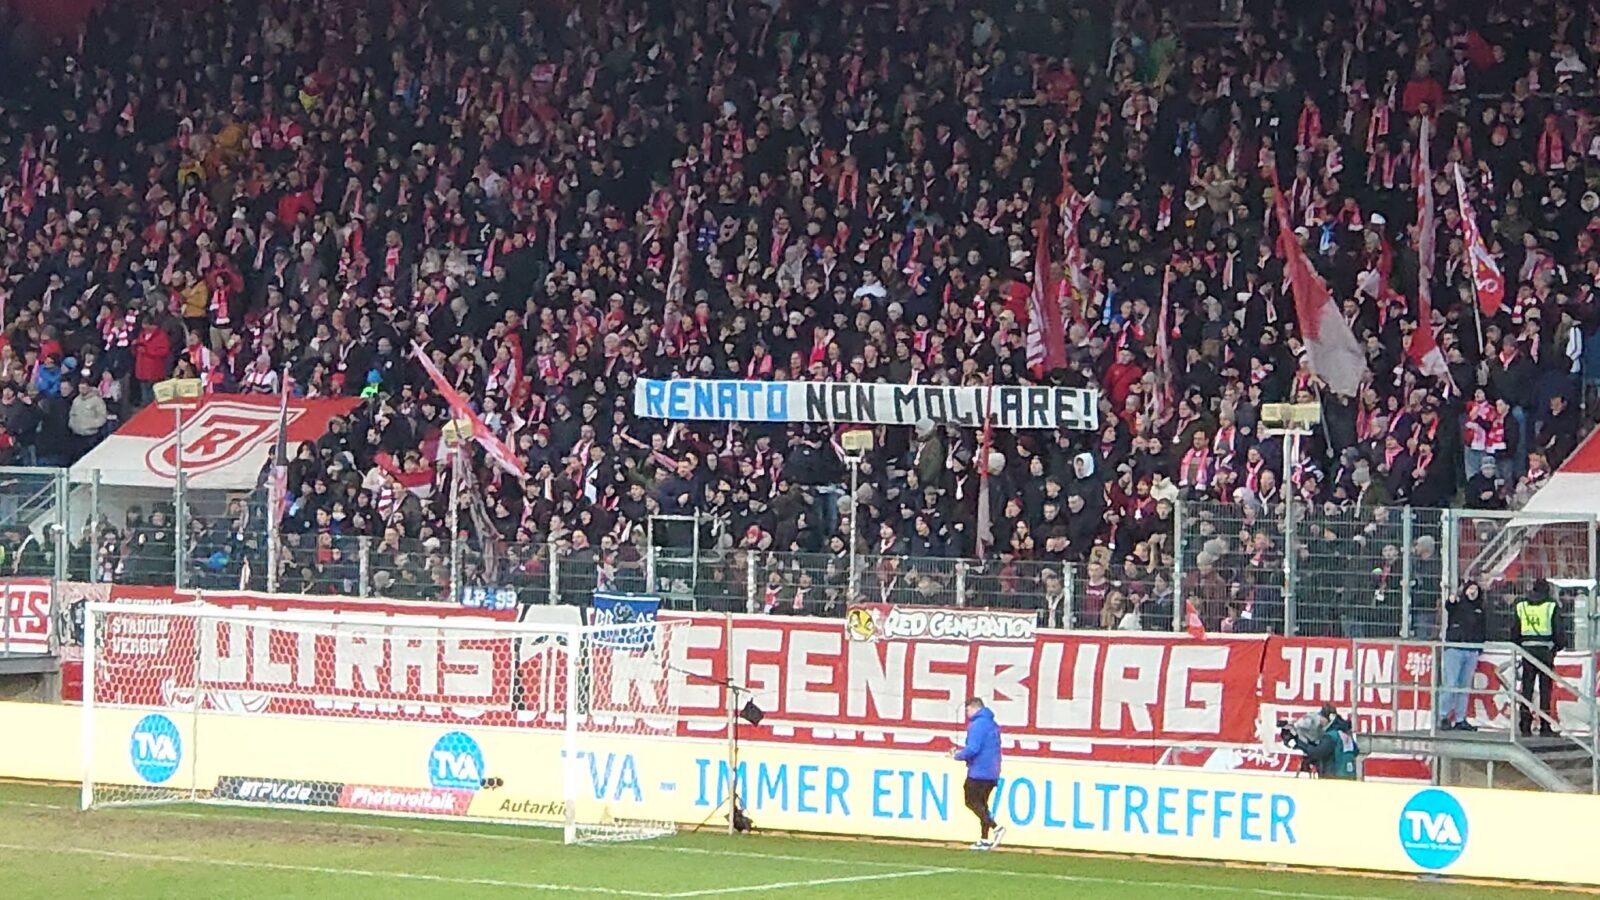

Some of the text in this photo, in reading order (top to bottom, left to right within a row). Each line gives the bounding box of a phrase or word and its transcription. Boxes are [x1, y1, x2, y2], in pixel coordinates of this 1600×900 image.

[645, 381, 1093, 429] RENATO NON MOLLARE!
[0, 591, 49, 634] RS
[883, 609, 1036, 639] RED GENERATION
[199, 605, 496, 698] ULTRAS
[611, 622, 1230, 734] REGENSBURG
[1275, 646, 1395, 703] JAHN
[135, 732, 177, 761] TVA
[433, 751, 480, 780] TVA
[561, 750, 643, 802] VA
[694, 758, 851, 816] IMMER
[872, 769, 950, 821] EIN
[499, 799, 567, 815] Autarki
[1405, 810, 1463, 844] TVA
